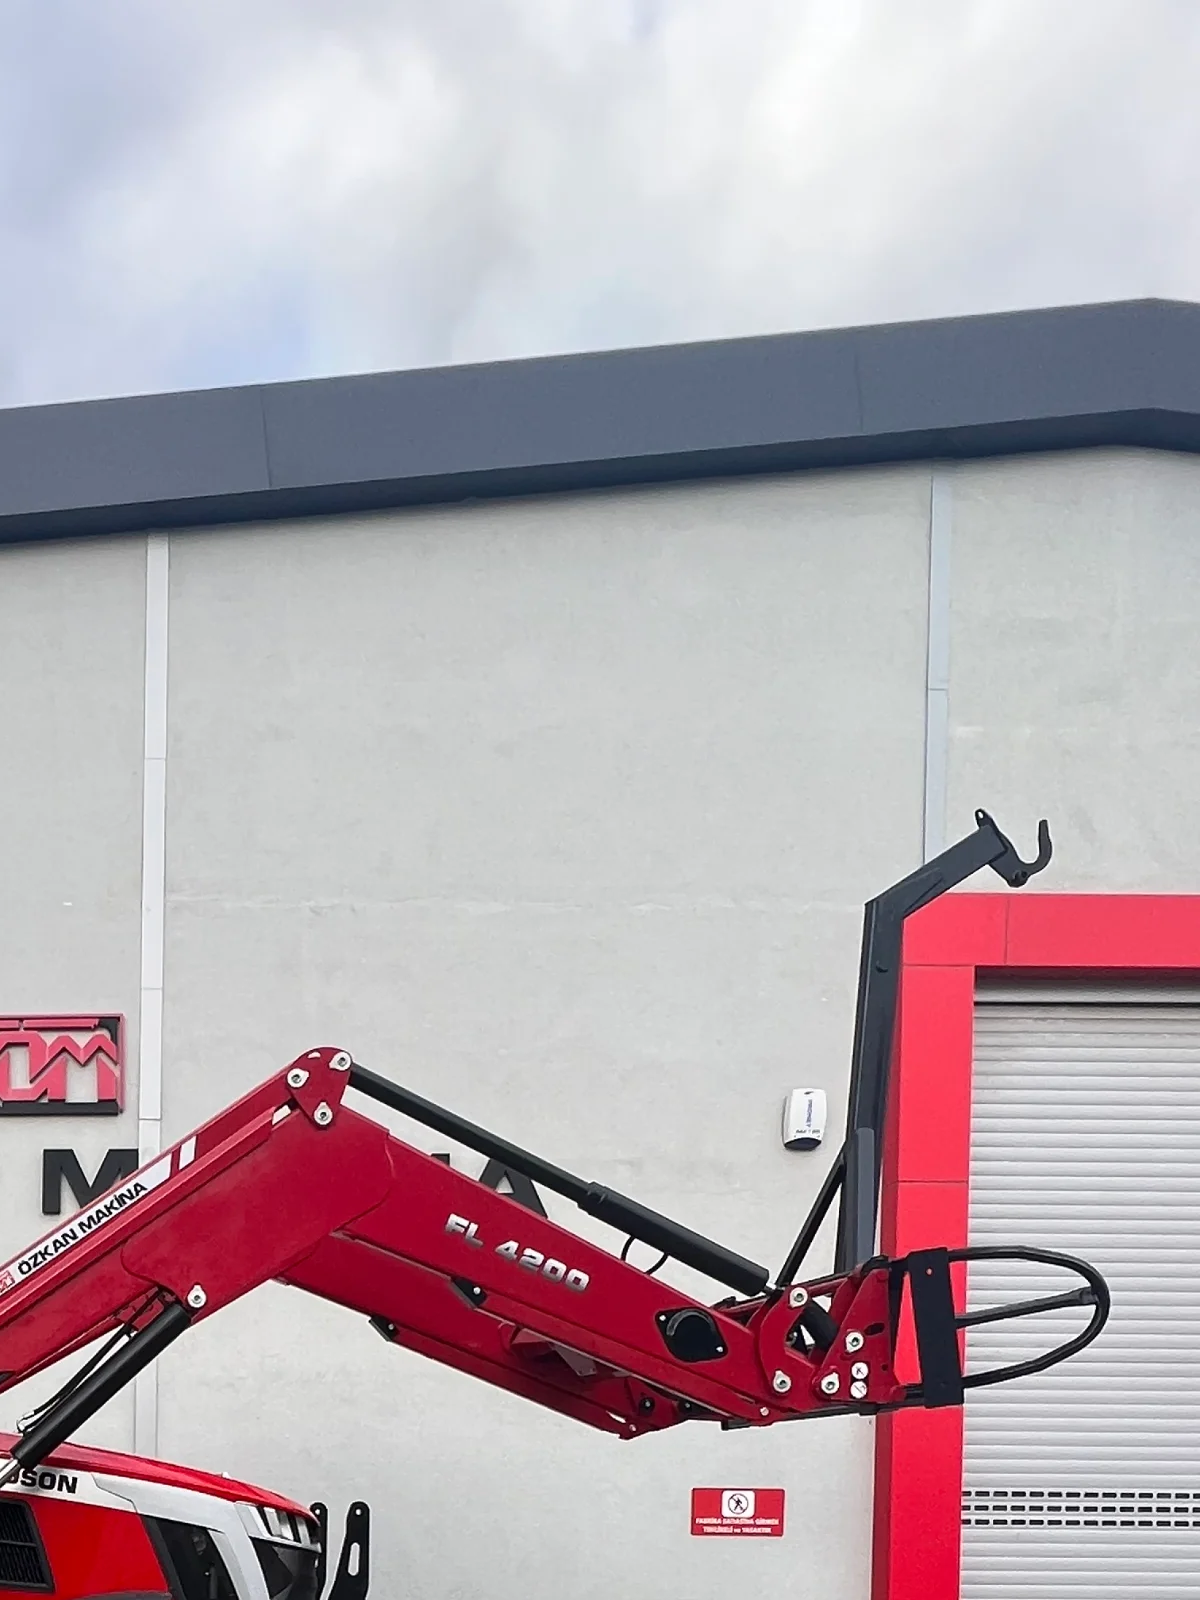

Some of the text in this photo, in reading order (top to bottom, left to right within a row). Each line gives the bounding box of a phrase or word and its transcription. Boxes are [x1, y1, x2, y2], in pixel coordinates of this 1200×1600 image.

[17, 1182, 148, 1276] ÖZKAN MAKİNA
[445, 1213, 590, 1293] FL 4200
